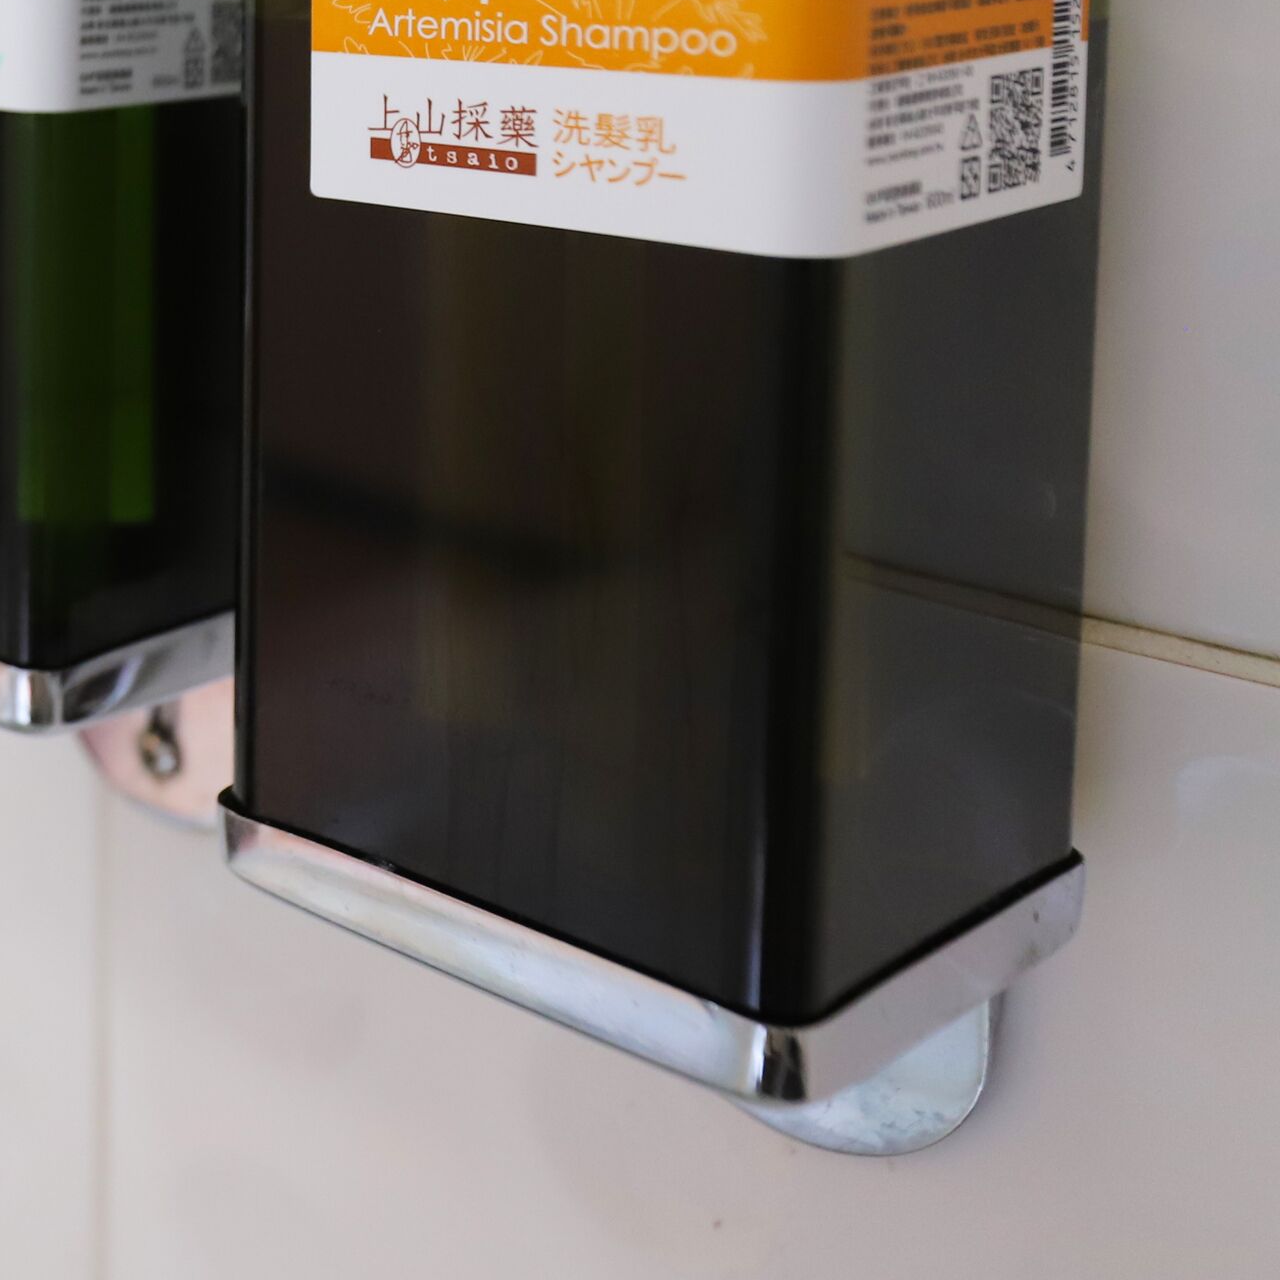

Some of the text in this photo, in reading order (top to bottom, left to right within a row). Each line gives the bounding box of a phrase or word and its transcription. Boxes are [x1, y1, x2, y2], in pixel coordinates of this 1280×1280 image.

[368, 7, 738, 61] Artemisia Shampoo
[368, 93, 539, 149] 上山採藥
[552, 107, 678, 154] 洗髮乳
[426, 144, 519, 172] tsaio
